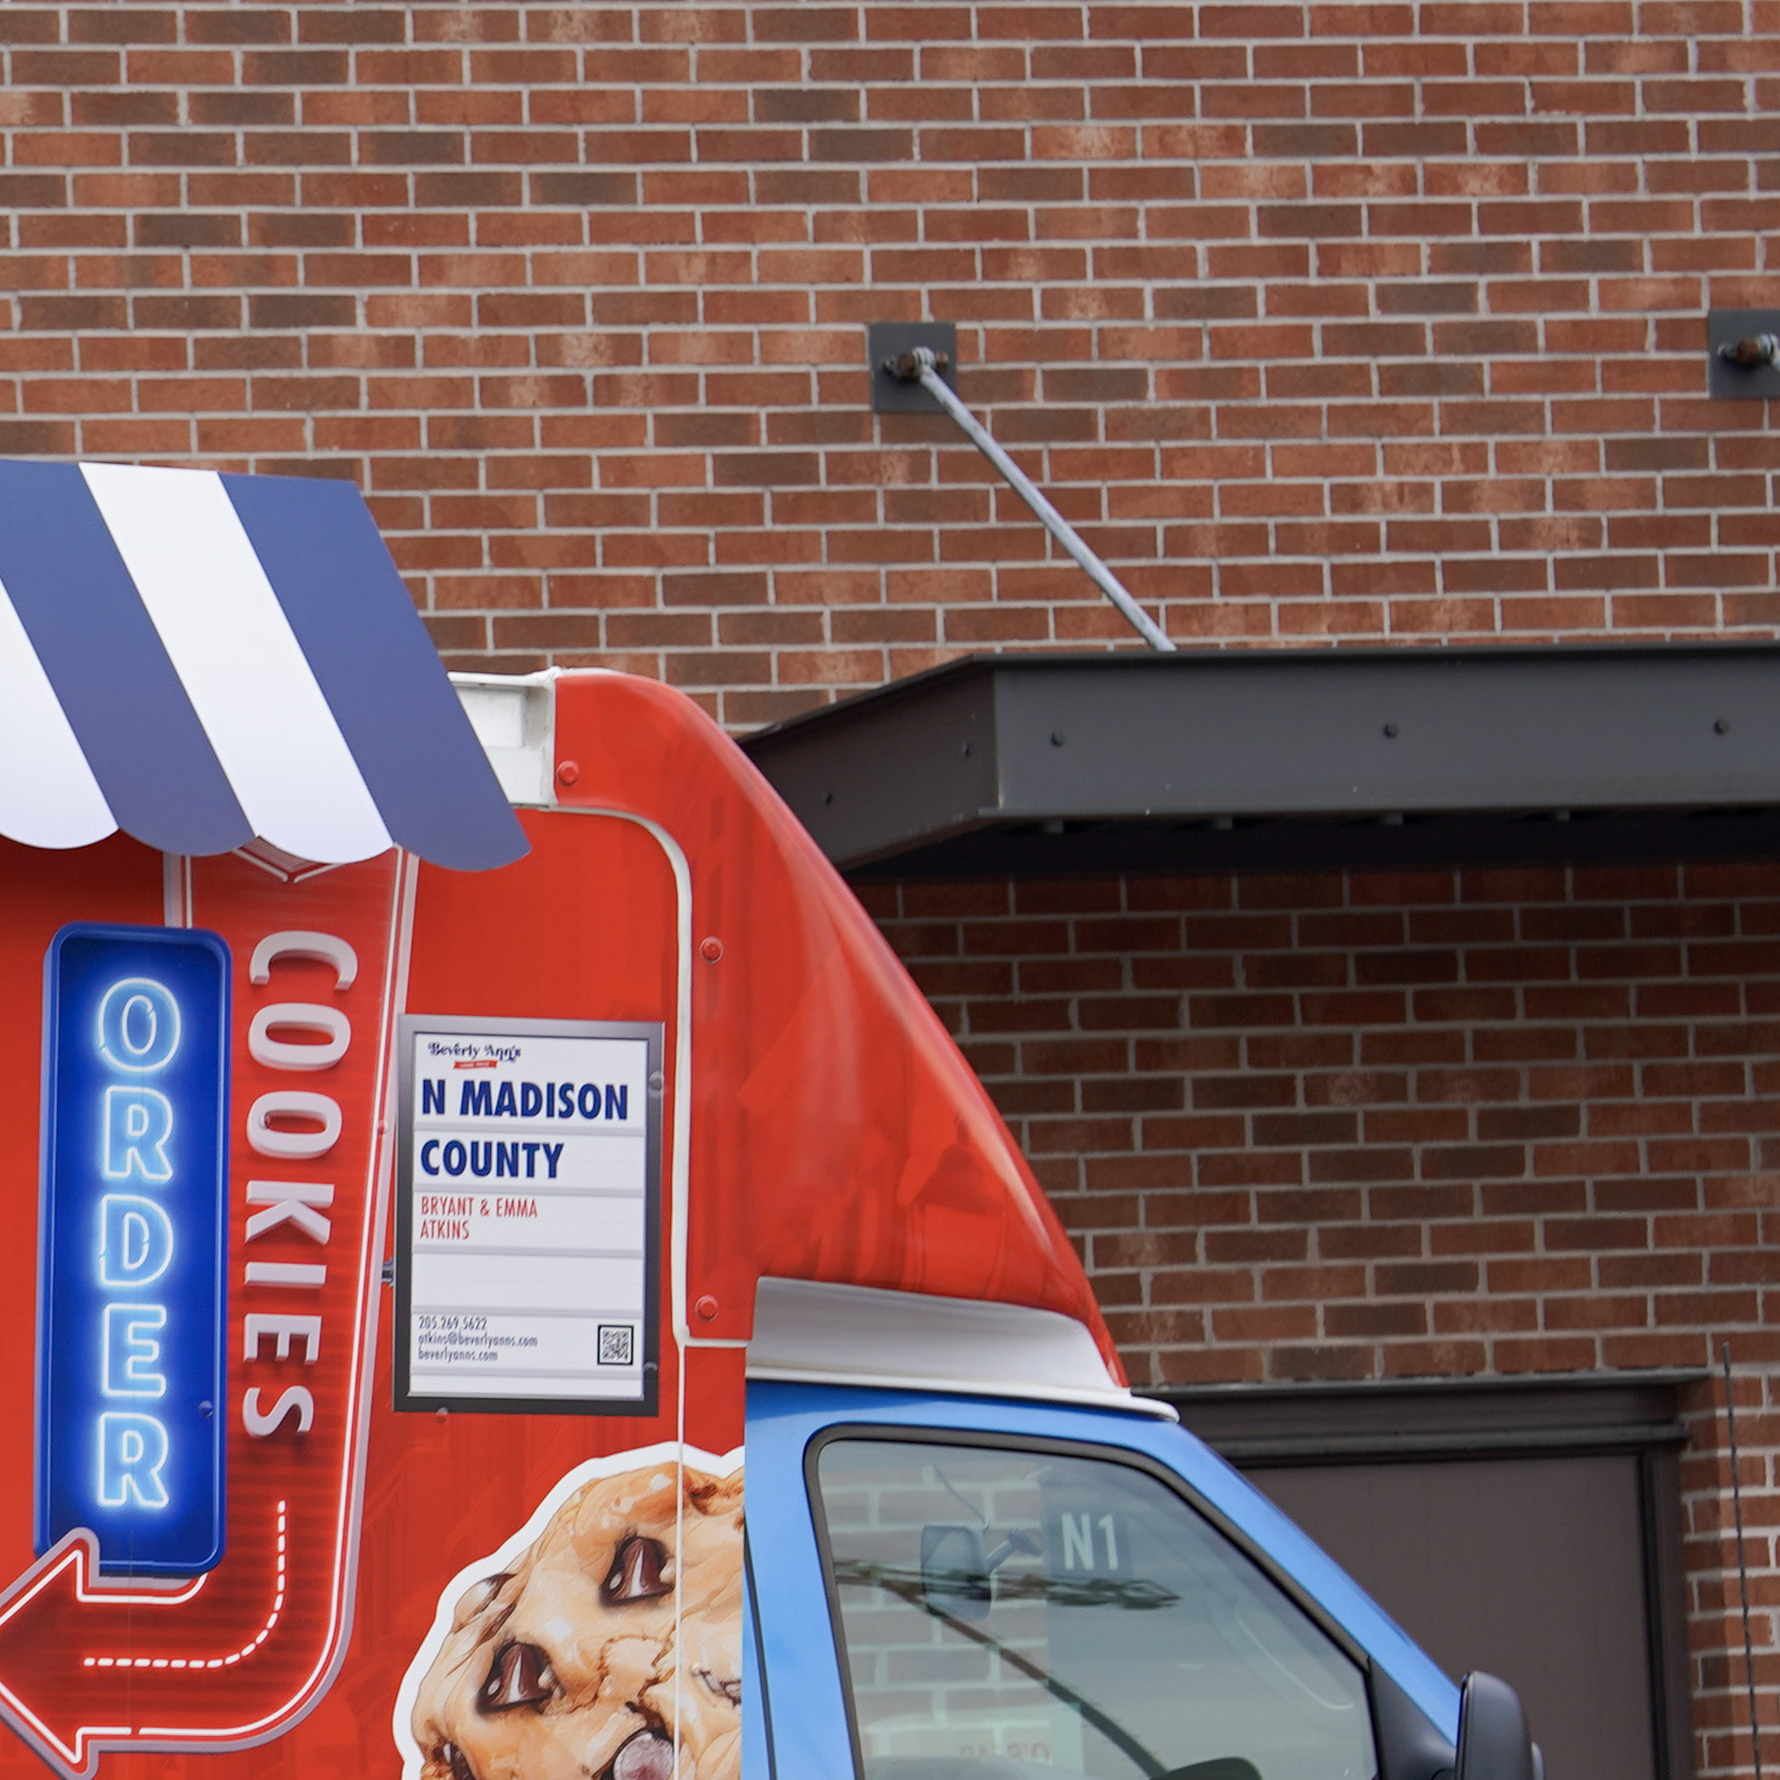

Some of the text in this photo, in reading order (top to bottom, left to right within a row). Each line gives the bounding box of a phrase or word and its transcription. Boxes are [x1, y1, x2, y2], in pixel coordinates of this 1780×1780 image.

[422, 1079, 628, 1119] N MADISON
[421, 1139, 564, 1179] COUNTY
[243, 930, 359, 1438] COOKIES
[421, 1196, 538, 1218] BRYANT & EMMA
[96, 975, 183, 1512] ORDER
[420, 1220, 469, 1240] ATKINS
[1061, 1511, 1119, 1571] N1
